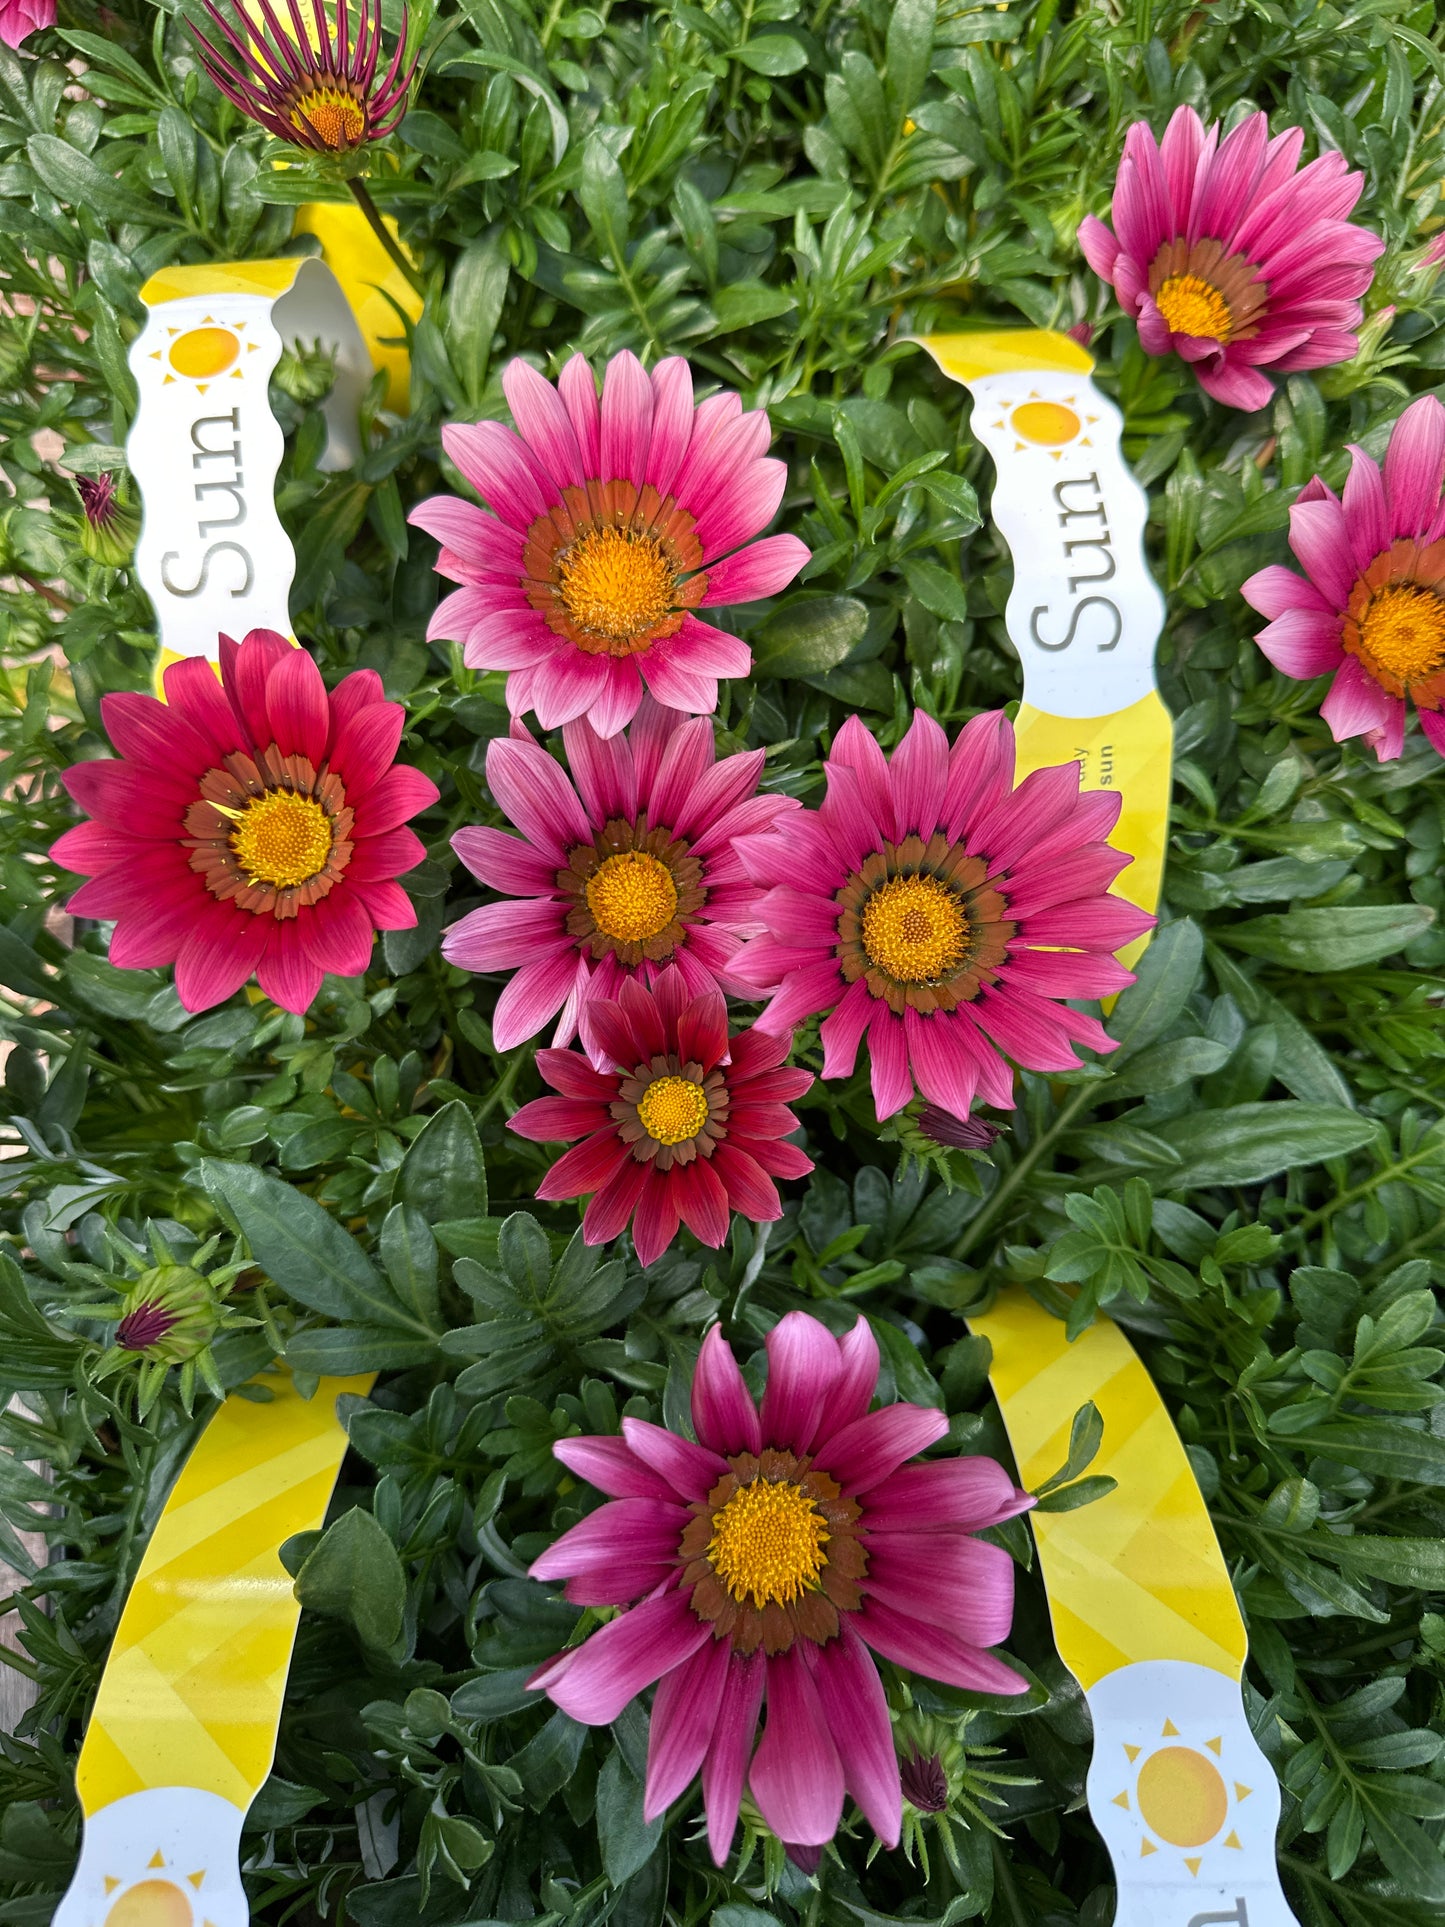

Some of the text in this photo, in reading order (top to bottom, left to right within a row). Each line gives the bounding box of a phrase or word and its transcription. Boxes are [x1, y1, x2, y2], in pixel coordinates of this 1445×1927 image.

[161, 407, 254, 600] Sun
[1030, 471, 1122, 652] Sun
[1100, 745, 1112, 786] sun
